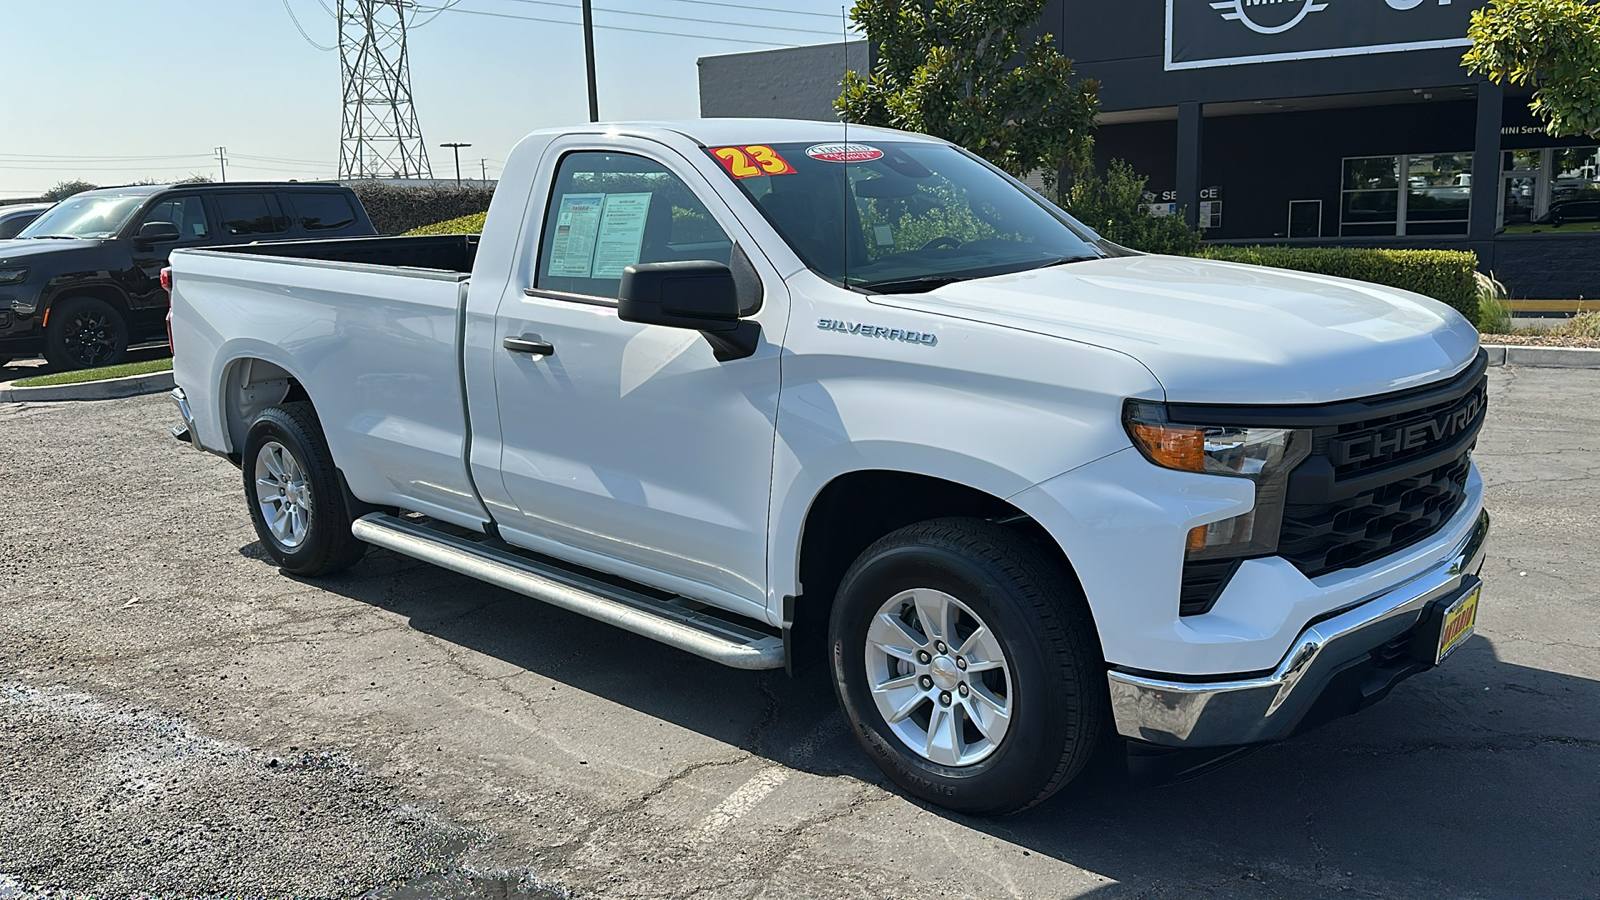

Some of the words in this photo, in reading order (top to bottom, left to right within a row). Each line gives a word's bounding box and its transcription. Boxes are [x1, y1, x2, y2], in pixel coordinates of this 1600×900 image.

[1521, 125, 1546, 134] Servi
[715, 145, 788, 176] 23
[817, 318, 938, 347] SILVERADO
[1335, 382, 1488, 465] CHEVROLE
